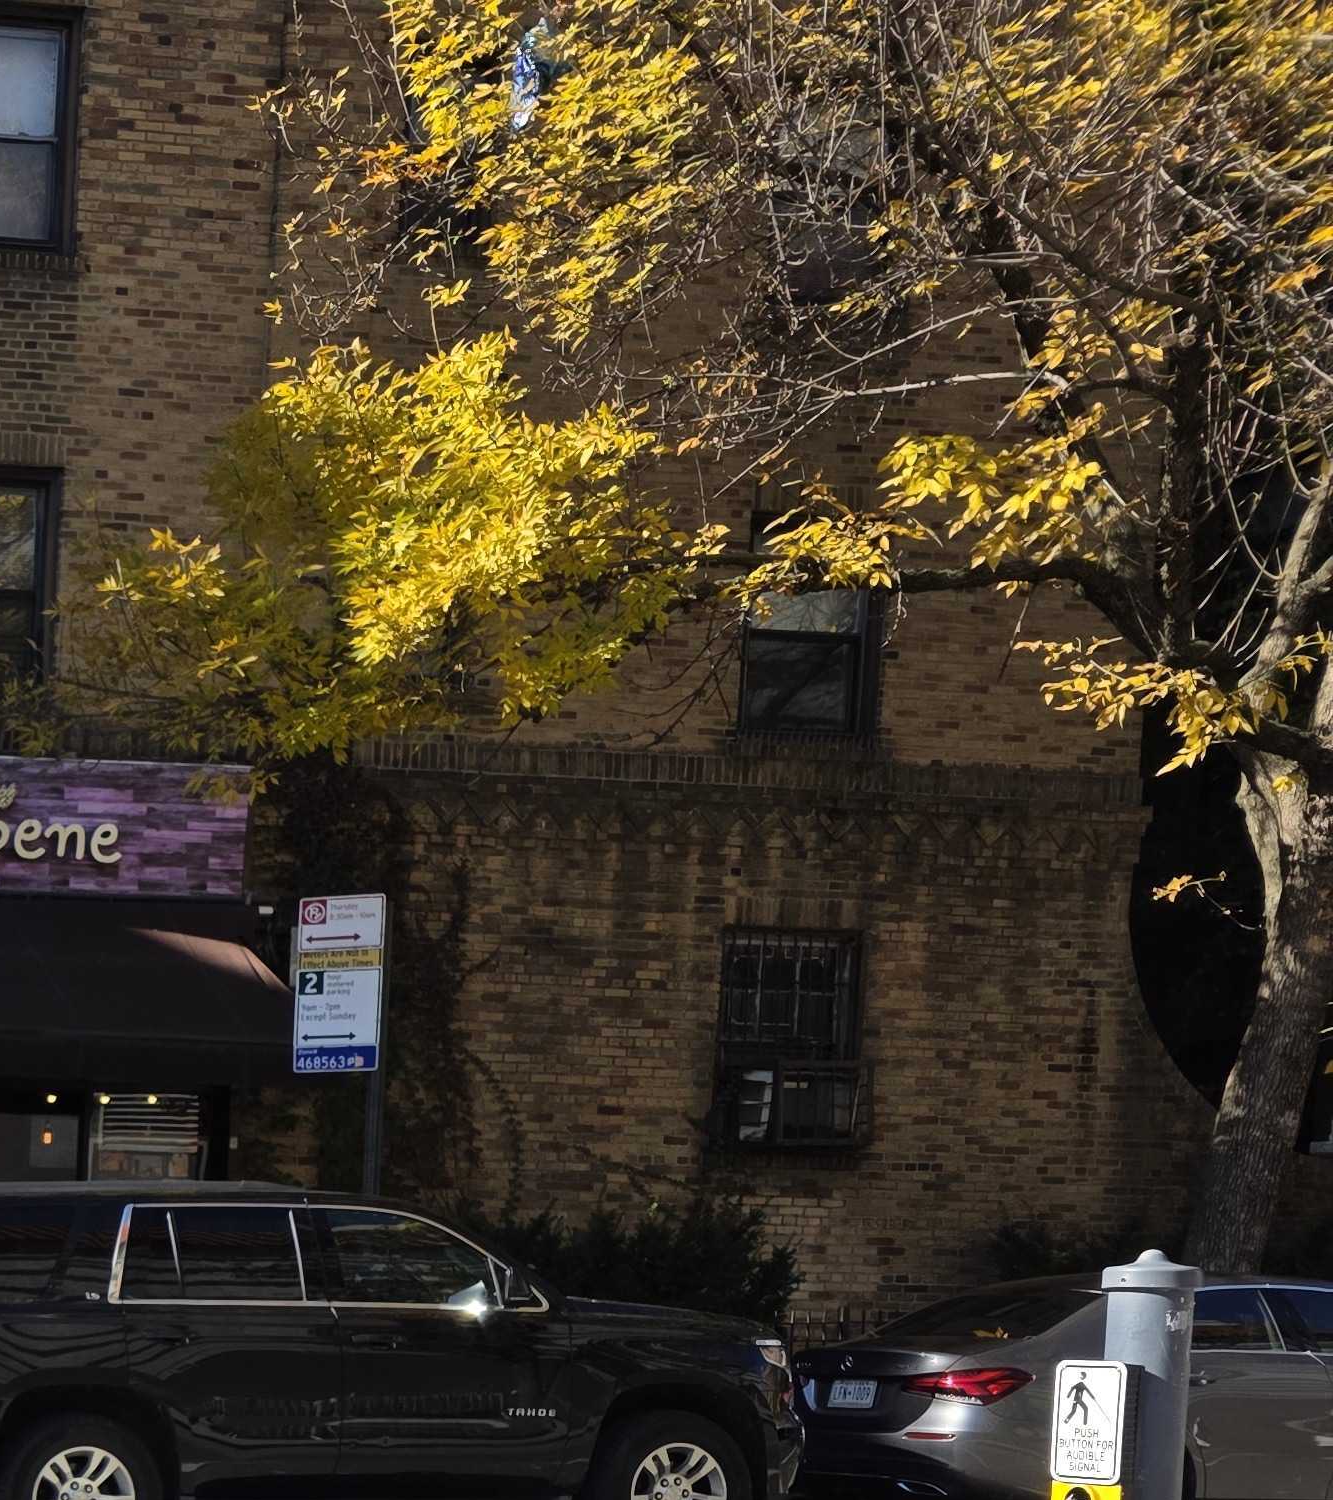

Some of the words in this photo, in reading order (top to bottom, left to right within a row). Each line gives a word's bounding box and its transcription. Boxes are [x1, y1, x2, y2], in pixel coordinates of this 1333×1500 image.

[304, 973, 318, 994] 2
[301, 1013, 326, 1022] Except
[329, 1012, 357, 1021] Sunday
[297, 1055, 345, 1069] 468563
[507, 1407, 557, 1417] TAHOE
[1074, 1427, 1099, 1438] PUSH
[1059, 1438, 1093, 1449] BUTTON
[1096, 1440, 1114, 1450] FOR
[1067, 1450, 1105, 1462] AUDIBLE
[1069, 1461, 1101, 1473] SIGNAL
